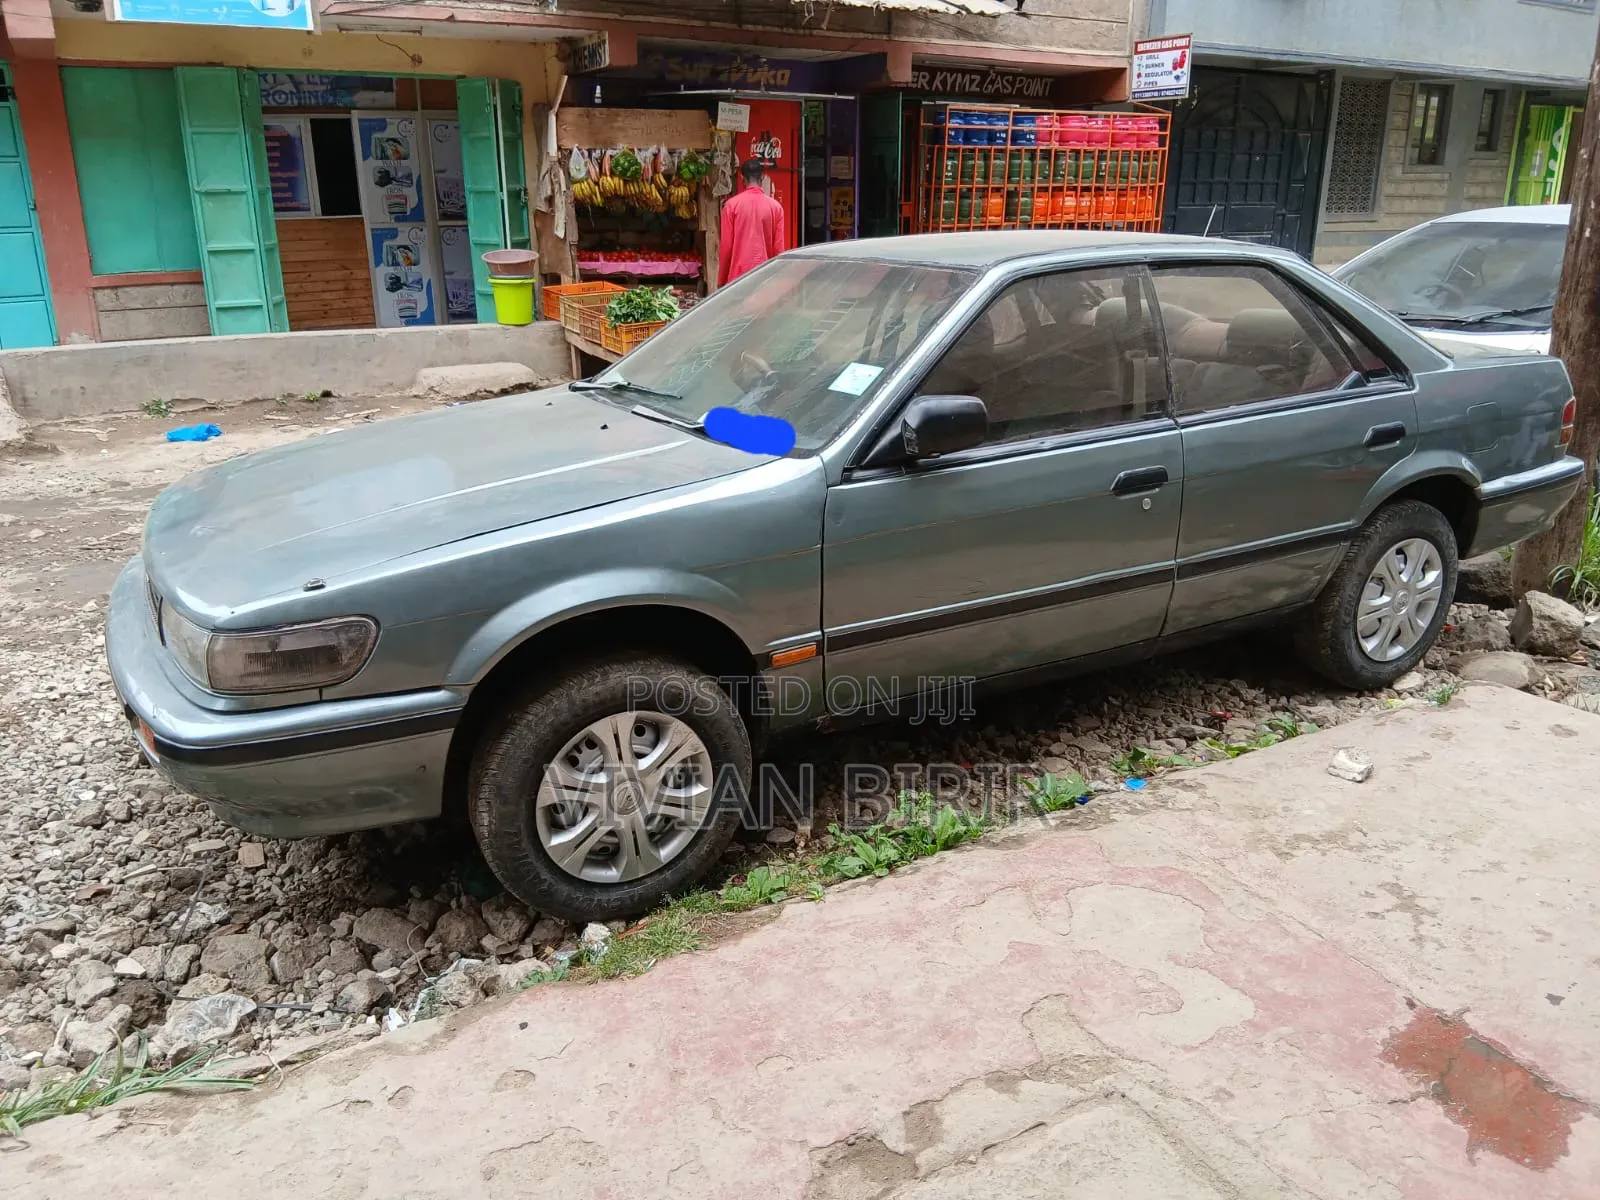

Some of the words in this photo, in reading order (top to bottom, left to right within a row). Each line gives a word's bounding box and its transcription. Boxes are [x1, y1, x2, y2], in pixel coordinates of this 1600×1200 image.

[1162, 40, 1172, 49] GAS
[1144, 70, 1173, 78] REGULATOR
[1012, 76, 1054, 97] POINT
